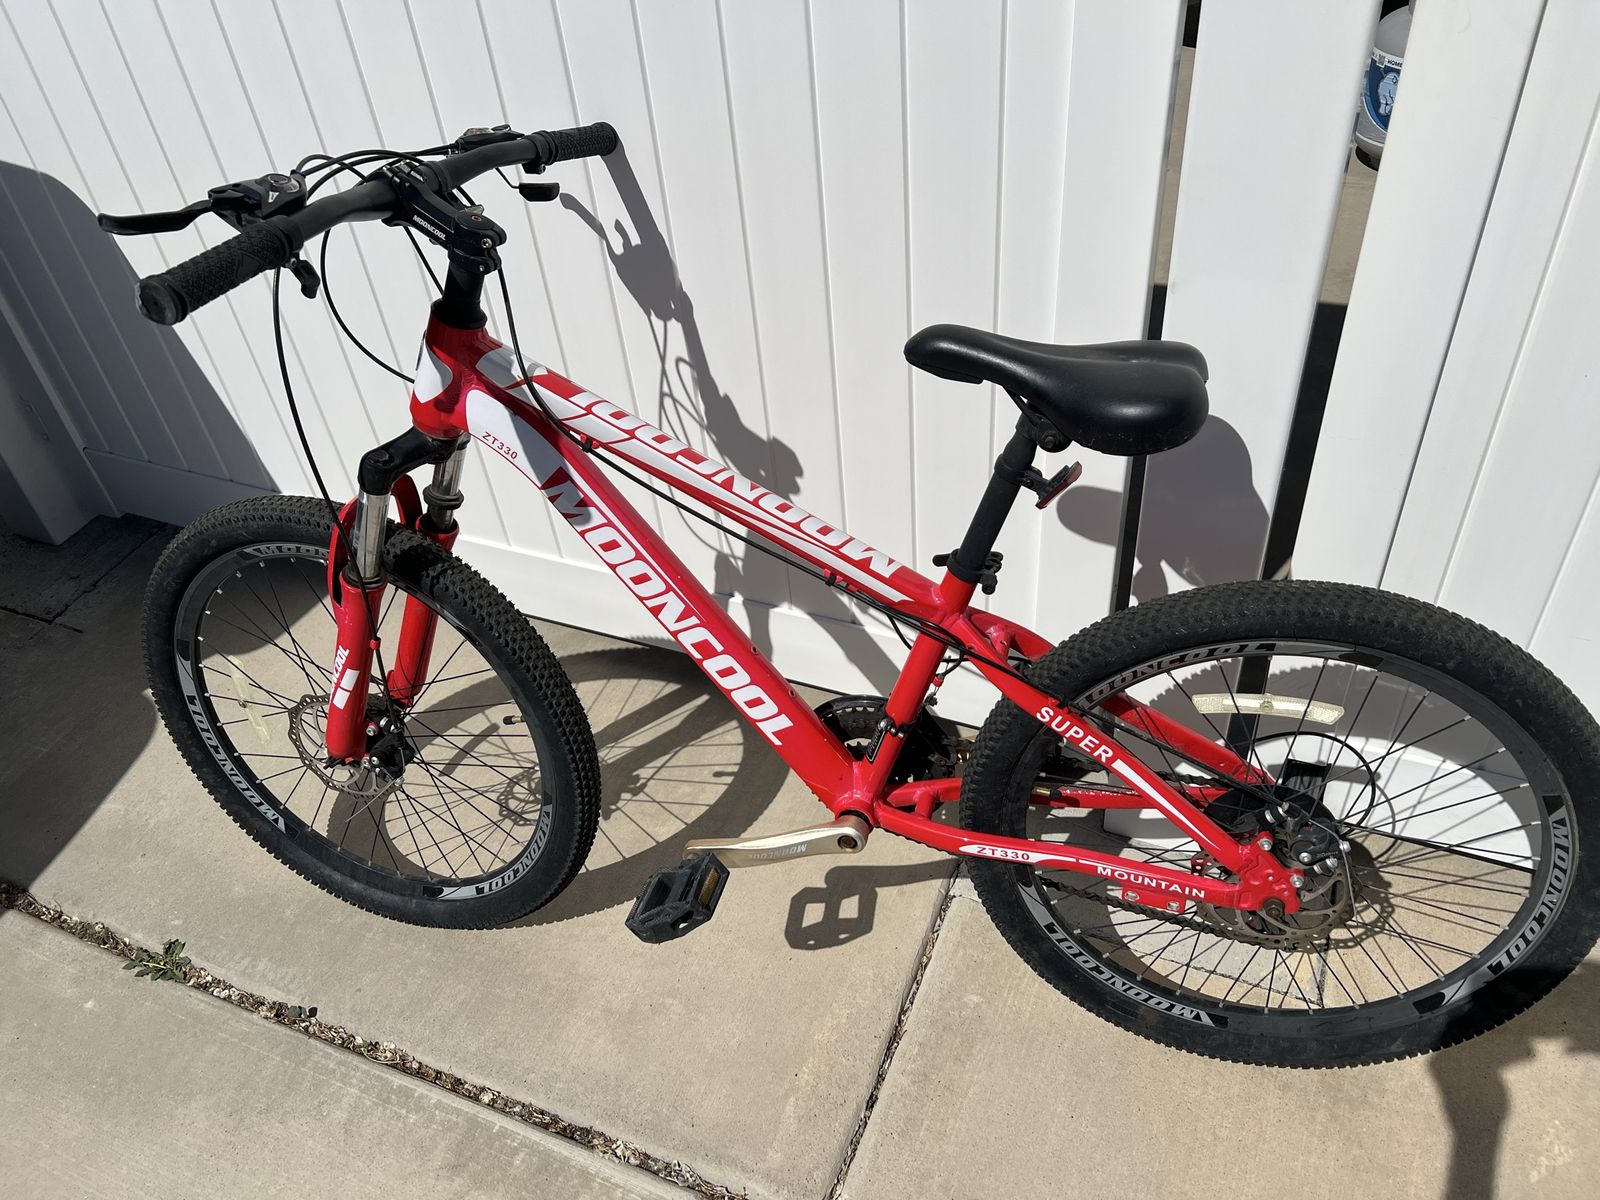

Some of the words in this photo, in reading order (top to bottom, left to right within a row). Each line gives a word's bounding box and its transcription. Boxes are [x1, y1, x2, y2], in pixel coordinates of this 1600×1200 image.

[413, 214, 446, 240] MOONCOOL
[482, 431, 518, 459] ZT330
[259, 545, 331, 558] MOON
[543, 480, 794, 745] MOONCOOL
[1036, 706, 1113, 763] SUPER
[188, 697, 279, 824] MOONCOOL
[478, 811, 551, 894] MOONCOOL
[750, 843, 807, 860] MOONCOO
[977, 846, 1030, 861] ZT330
[1097, 866, 1205, 899] MOUNTAIN
[1492, 818, 1570, 974] MOONCOOL
[1047, 924, 1199, 1020] MOONCOOL
